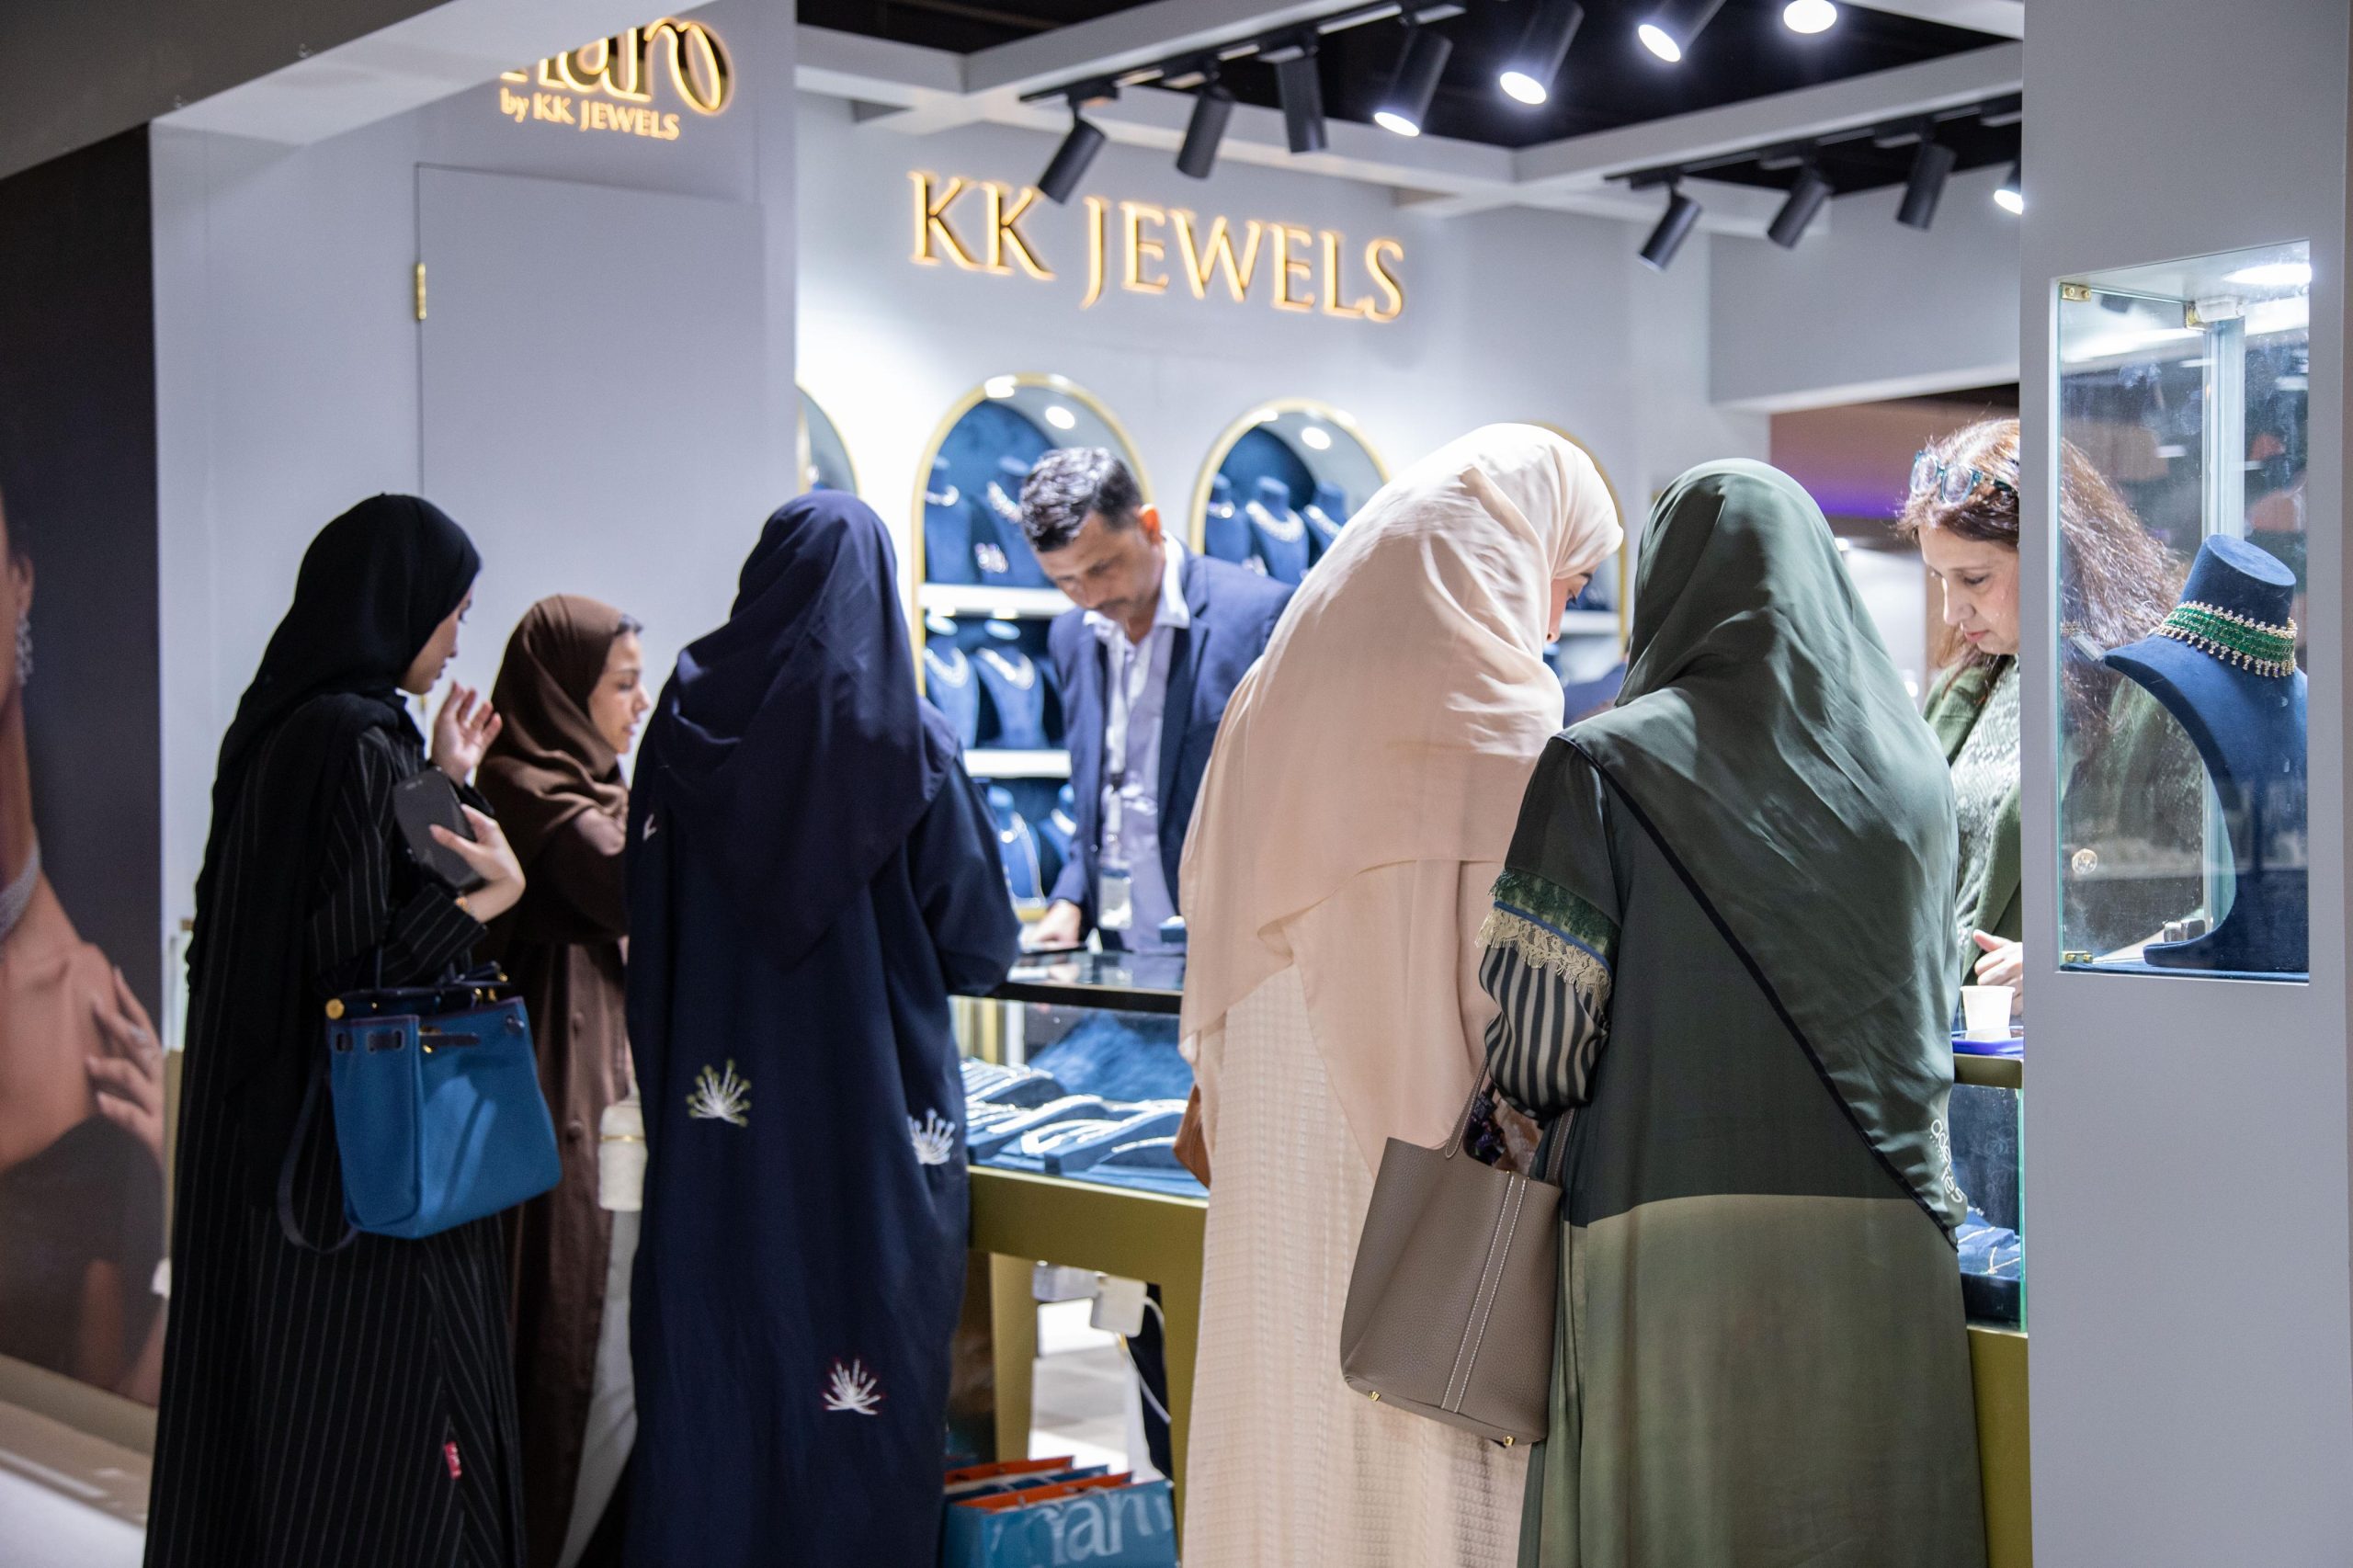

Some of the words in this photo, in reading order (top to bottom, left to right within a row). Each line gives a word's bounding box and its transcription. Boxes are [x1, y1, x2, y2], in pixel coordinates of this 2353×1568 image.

[500, 87, 529, 122] by
[533, 92, 575, 125] KK
[579, 99, 680, 141] JEWELS
[907, 170, 1056, 281] KK
[1079, 195, 1404, 323] JEWELS
